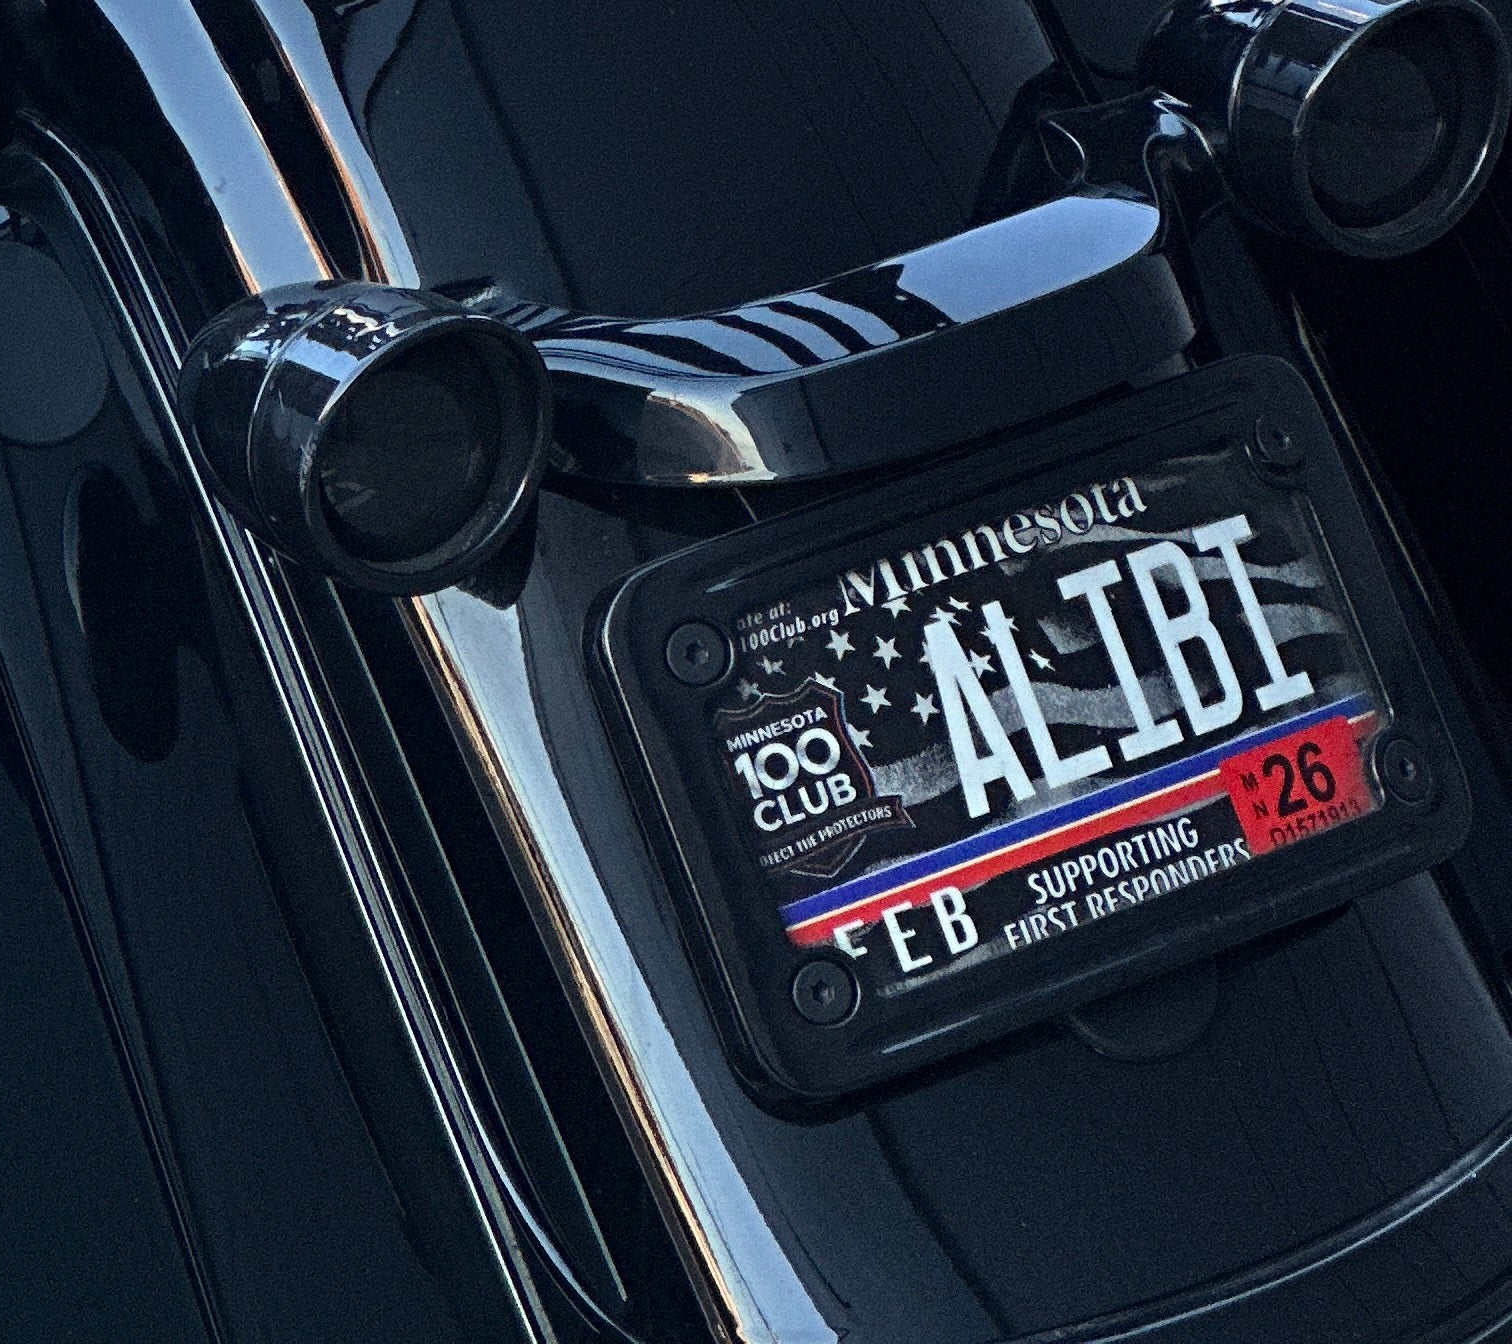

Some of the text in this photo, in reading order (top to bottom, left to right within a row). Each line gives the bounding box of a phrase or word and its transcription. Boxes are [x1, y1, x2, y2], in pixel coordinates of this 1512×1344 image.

[838, 476, 1147, 617] Minnesota
[736, 612, 763, 631] ate
[924, 514, 1315, 819] ALIBI
[727, 706, 828, 752] MINNESOTA
[734, 727, 840, 800] 100
[753, 773, 857, 832] CLUB
[1262, 741, 1337, 818] 26
[795, 832, 819, 853] THE
[818, 805, 893, 843] PROTECTORS
[1028, 817, 1199, 906] SUPPORTING
[832, 886, 979, 973] FEB
[1005, 838, 1251, 952] FIRST RESPONDERS
